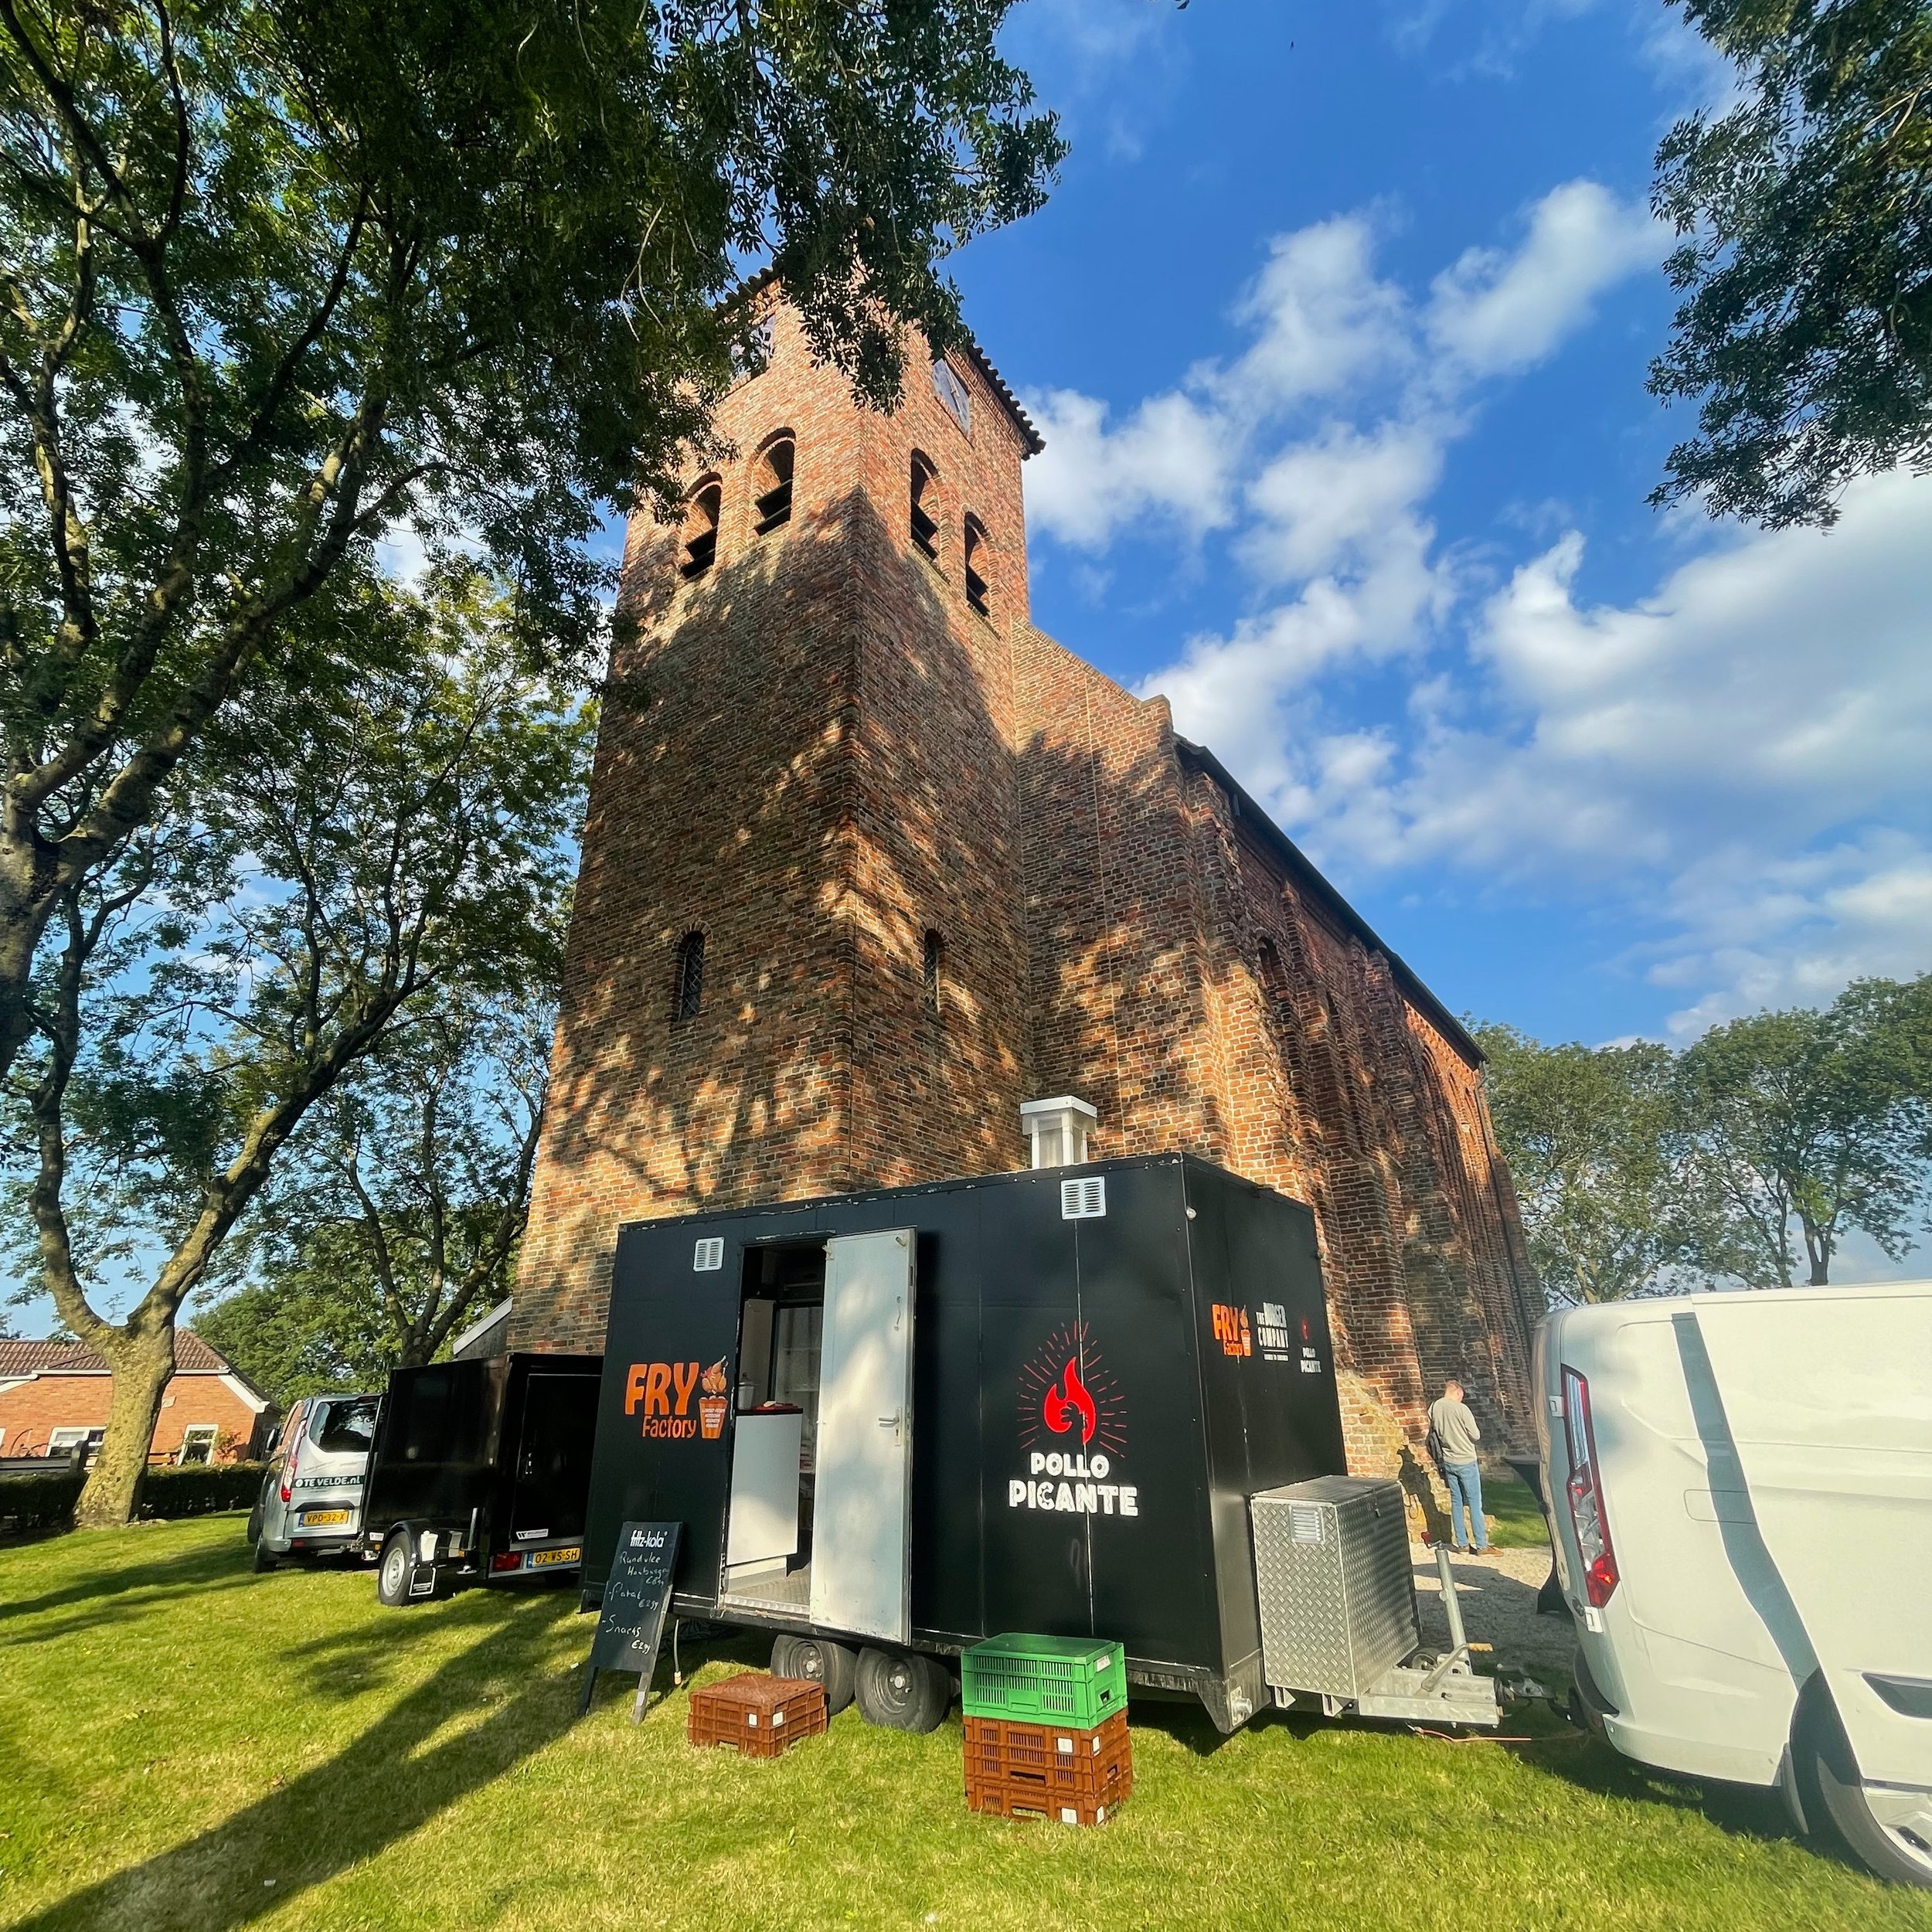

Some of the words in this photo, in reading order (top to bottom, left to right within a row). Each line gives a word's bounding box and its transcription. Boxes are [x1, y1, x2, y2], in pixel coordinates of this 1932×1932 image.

[1212, 1304, 1239, 1341] FRY
[1257, 1326, 1289, 1349] COMPANY
[1302, 1347, 1316, 1359] POLLO
[625, 1362, 699, 1416] FRY
[642, 1416, 697, 1439] Factory
[1030, 1452, 1110, 1479] POLLO
[1009, 1479, 1138, 1517] PICANTE
[307, 1512, 345, 1523] VPD-32-X
